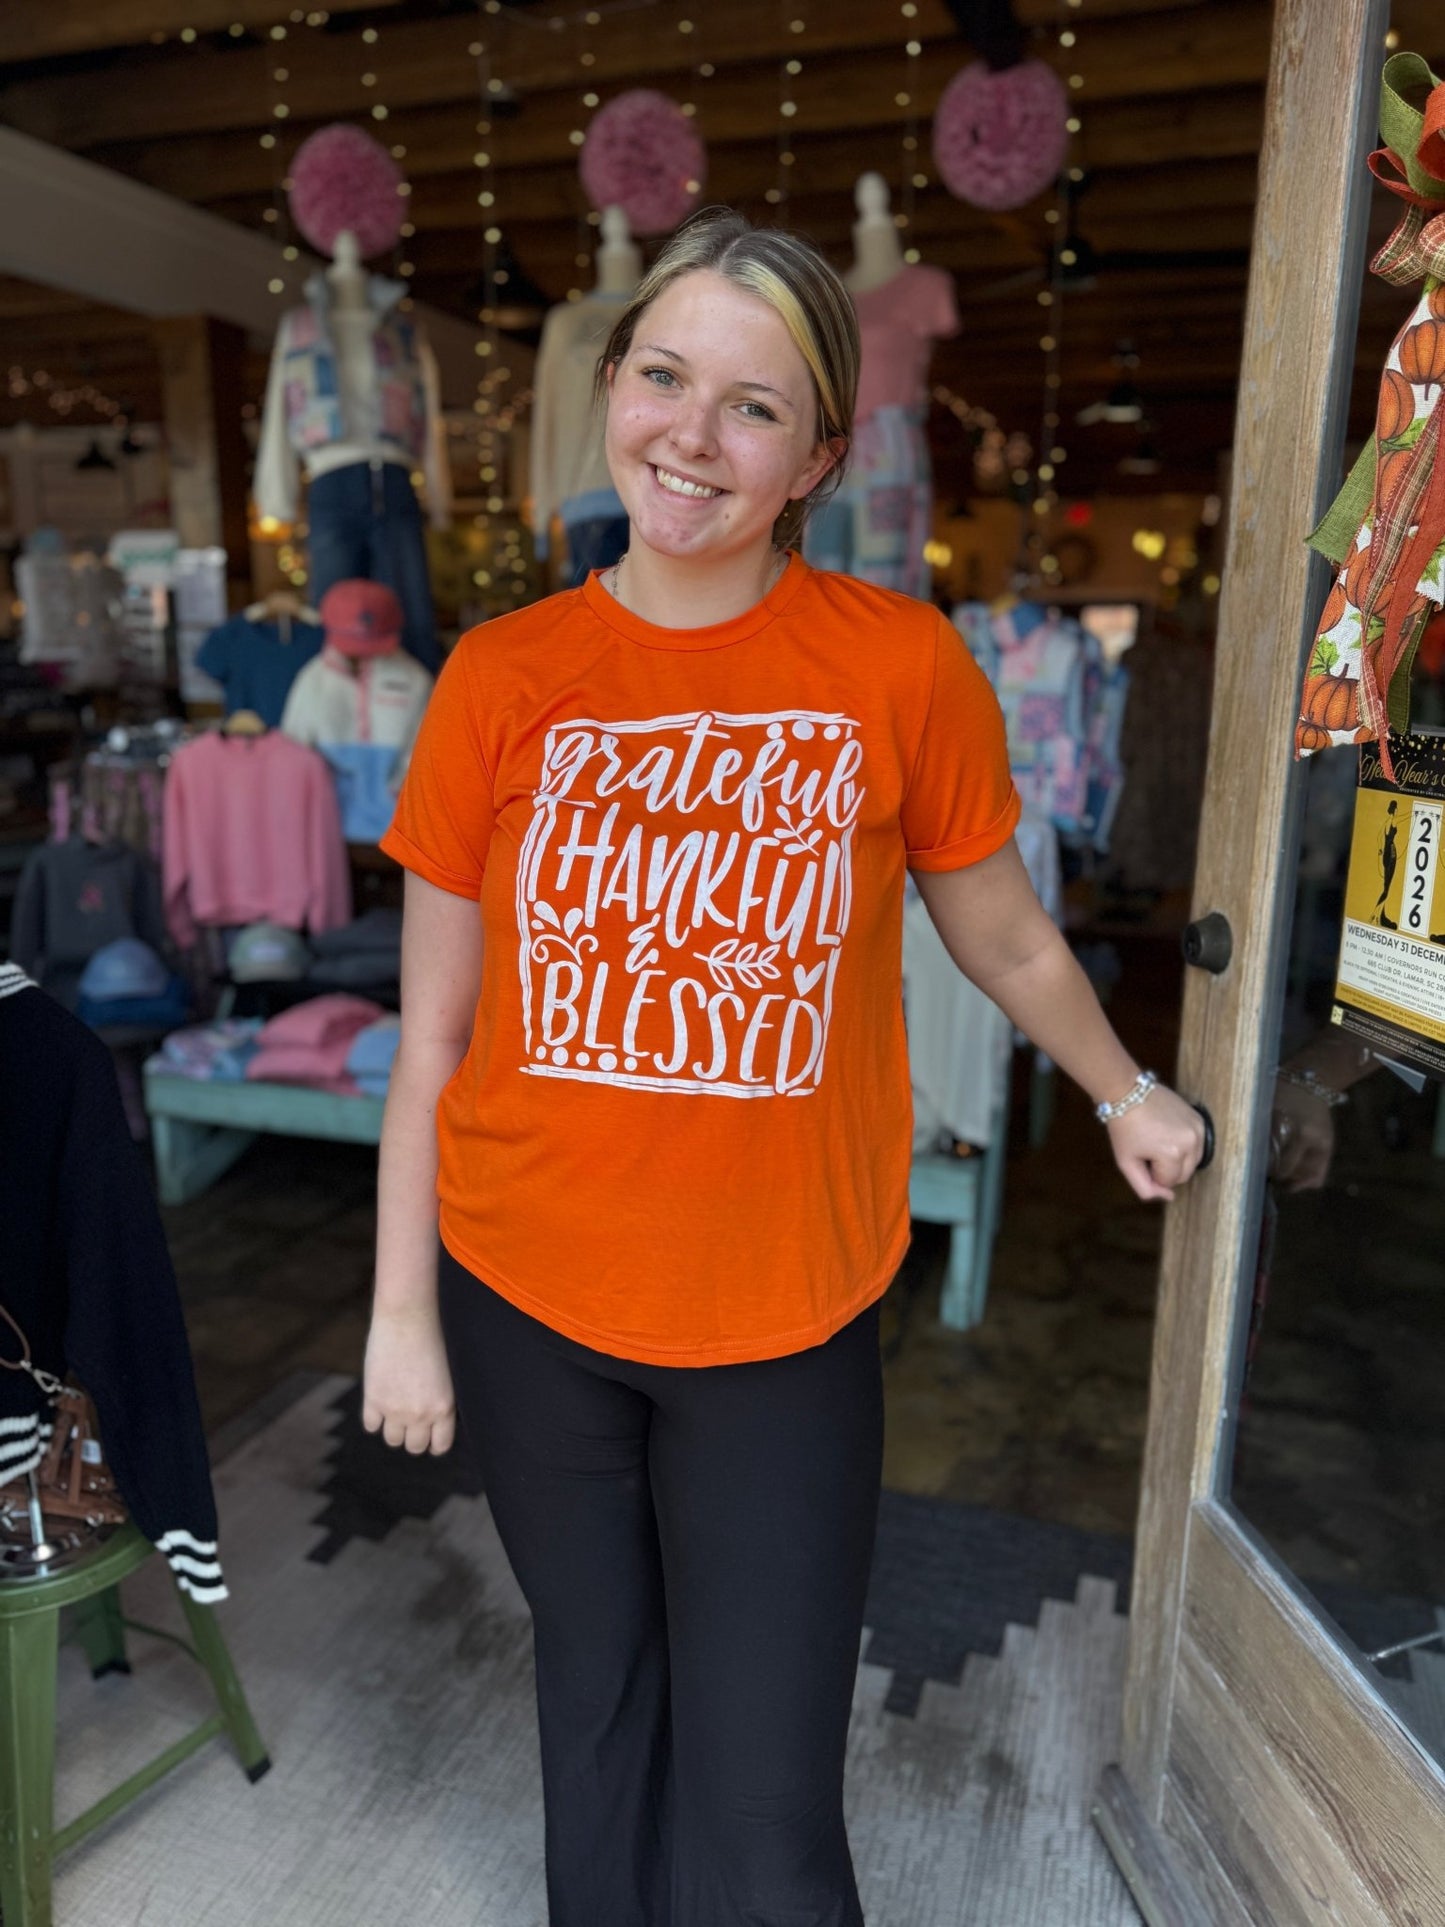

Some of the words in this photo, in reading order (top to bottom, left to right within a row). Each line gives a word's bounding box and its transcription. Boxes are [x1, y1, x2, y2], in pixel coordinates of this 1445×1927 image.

[535, 713, 866, 832] grateful
[1393, 759, 1440, 788] Year's
[527, 794, 842, 959] THANKFUL
[1408, 817, 1432, 928] 2026
[624, 913, 660, 974] &
[1347, 923, 1400, 949] WEDNESDAY
[1400, 942, 1409, 953] 31
[1375, 951, 1384, 959] AM
[1424, 968, 1437, 978] RUN
[1378, 963, 1392, 973] CLUB
[1426, 980, 1436, 989] SC
[541, 959, 826, 1094] BLESSED
